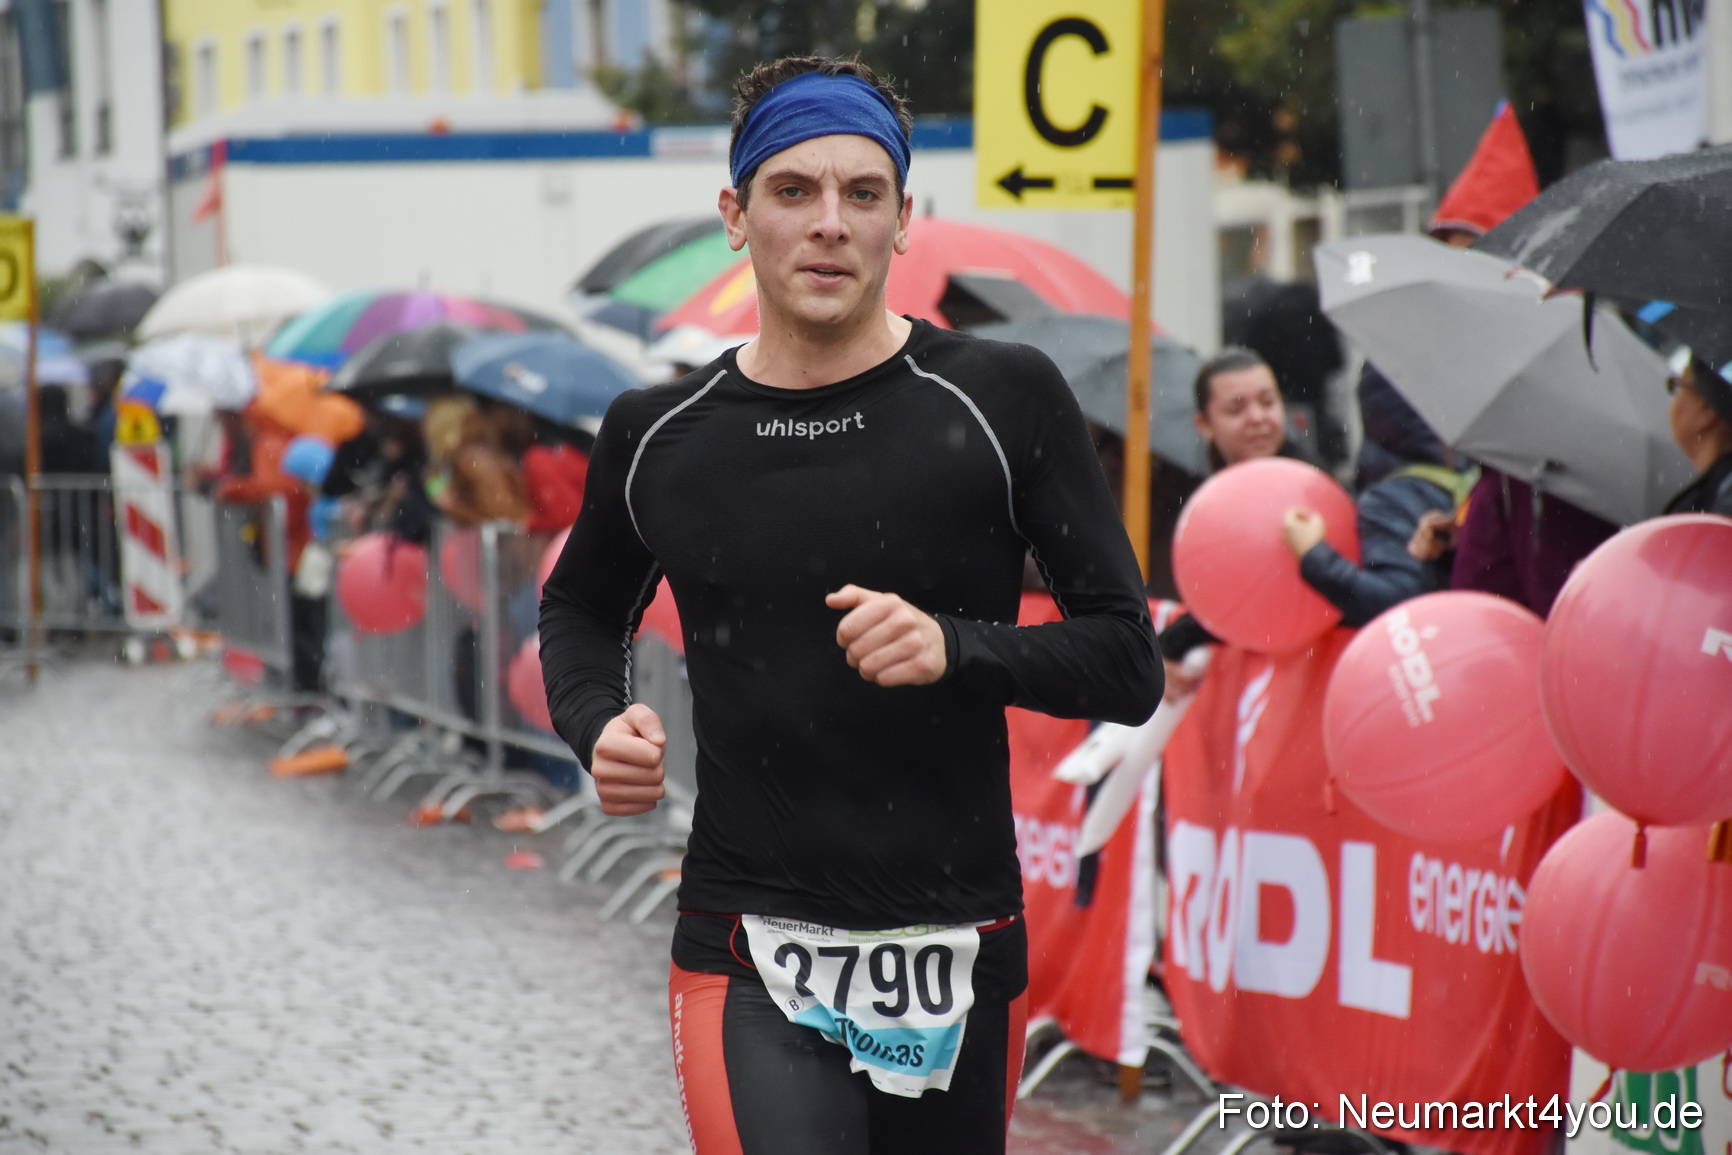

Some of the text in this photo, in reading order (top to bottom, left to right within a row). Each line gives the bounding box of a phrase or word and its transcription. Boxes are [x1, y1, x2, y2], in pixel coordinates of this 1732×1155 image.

[1025, 16, 1110, 147] C
[756, 411, 865, 440] uhlsport
[774, 942, 954, 1018] 2790
[835, 1017, 925, 1067] Thomas
